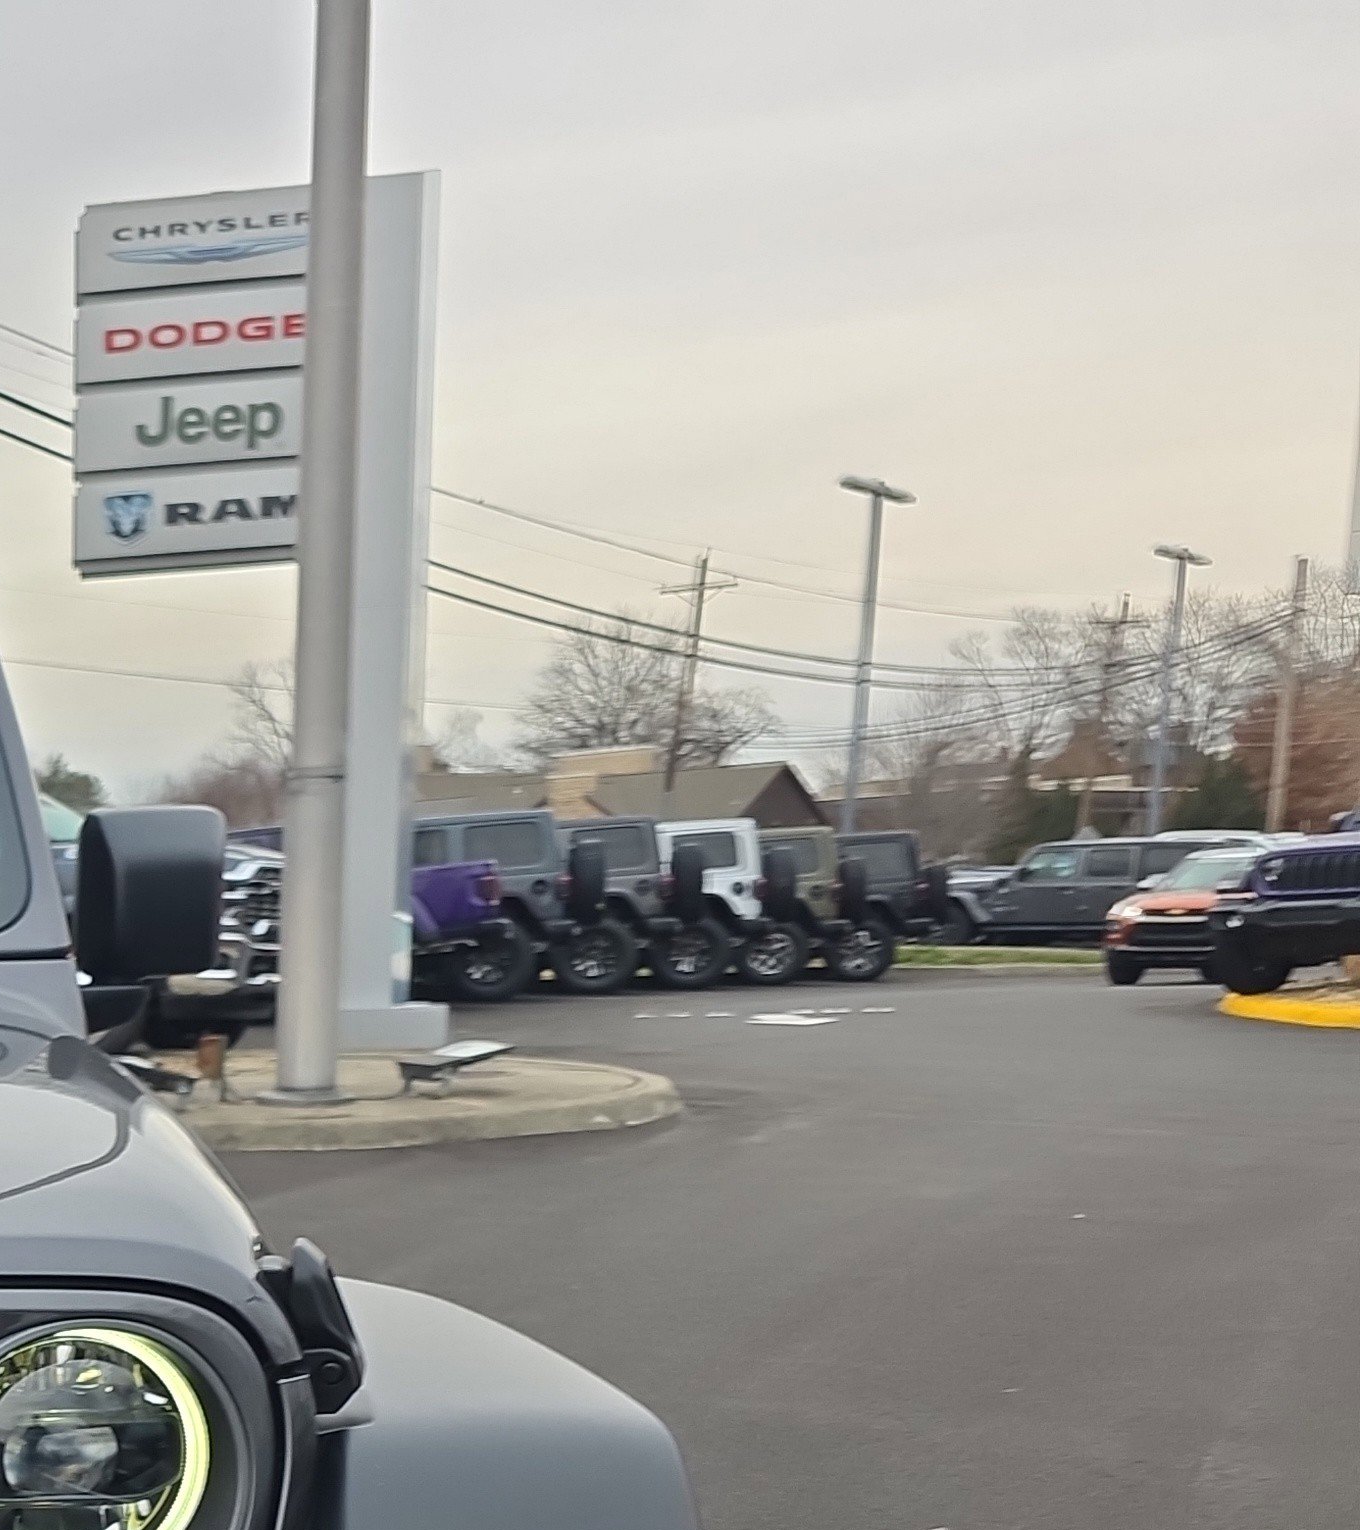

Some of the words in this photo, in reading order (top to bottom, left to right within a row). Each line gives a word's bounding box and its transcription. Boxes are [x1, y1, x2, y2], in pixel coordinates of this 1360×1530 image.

[112, 211, 309, 242] CHRYSLER
[104, 312, 306, 354] DODGE
[134, 396, 284, 450] Jeep
